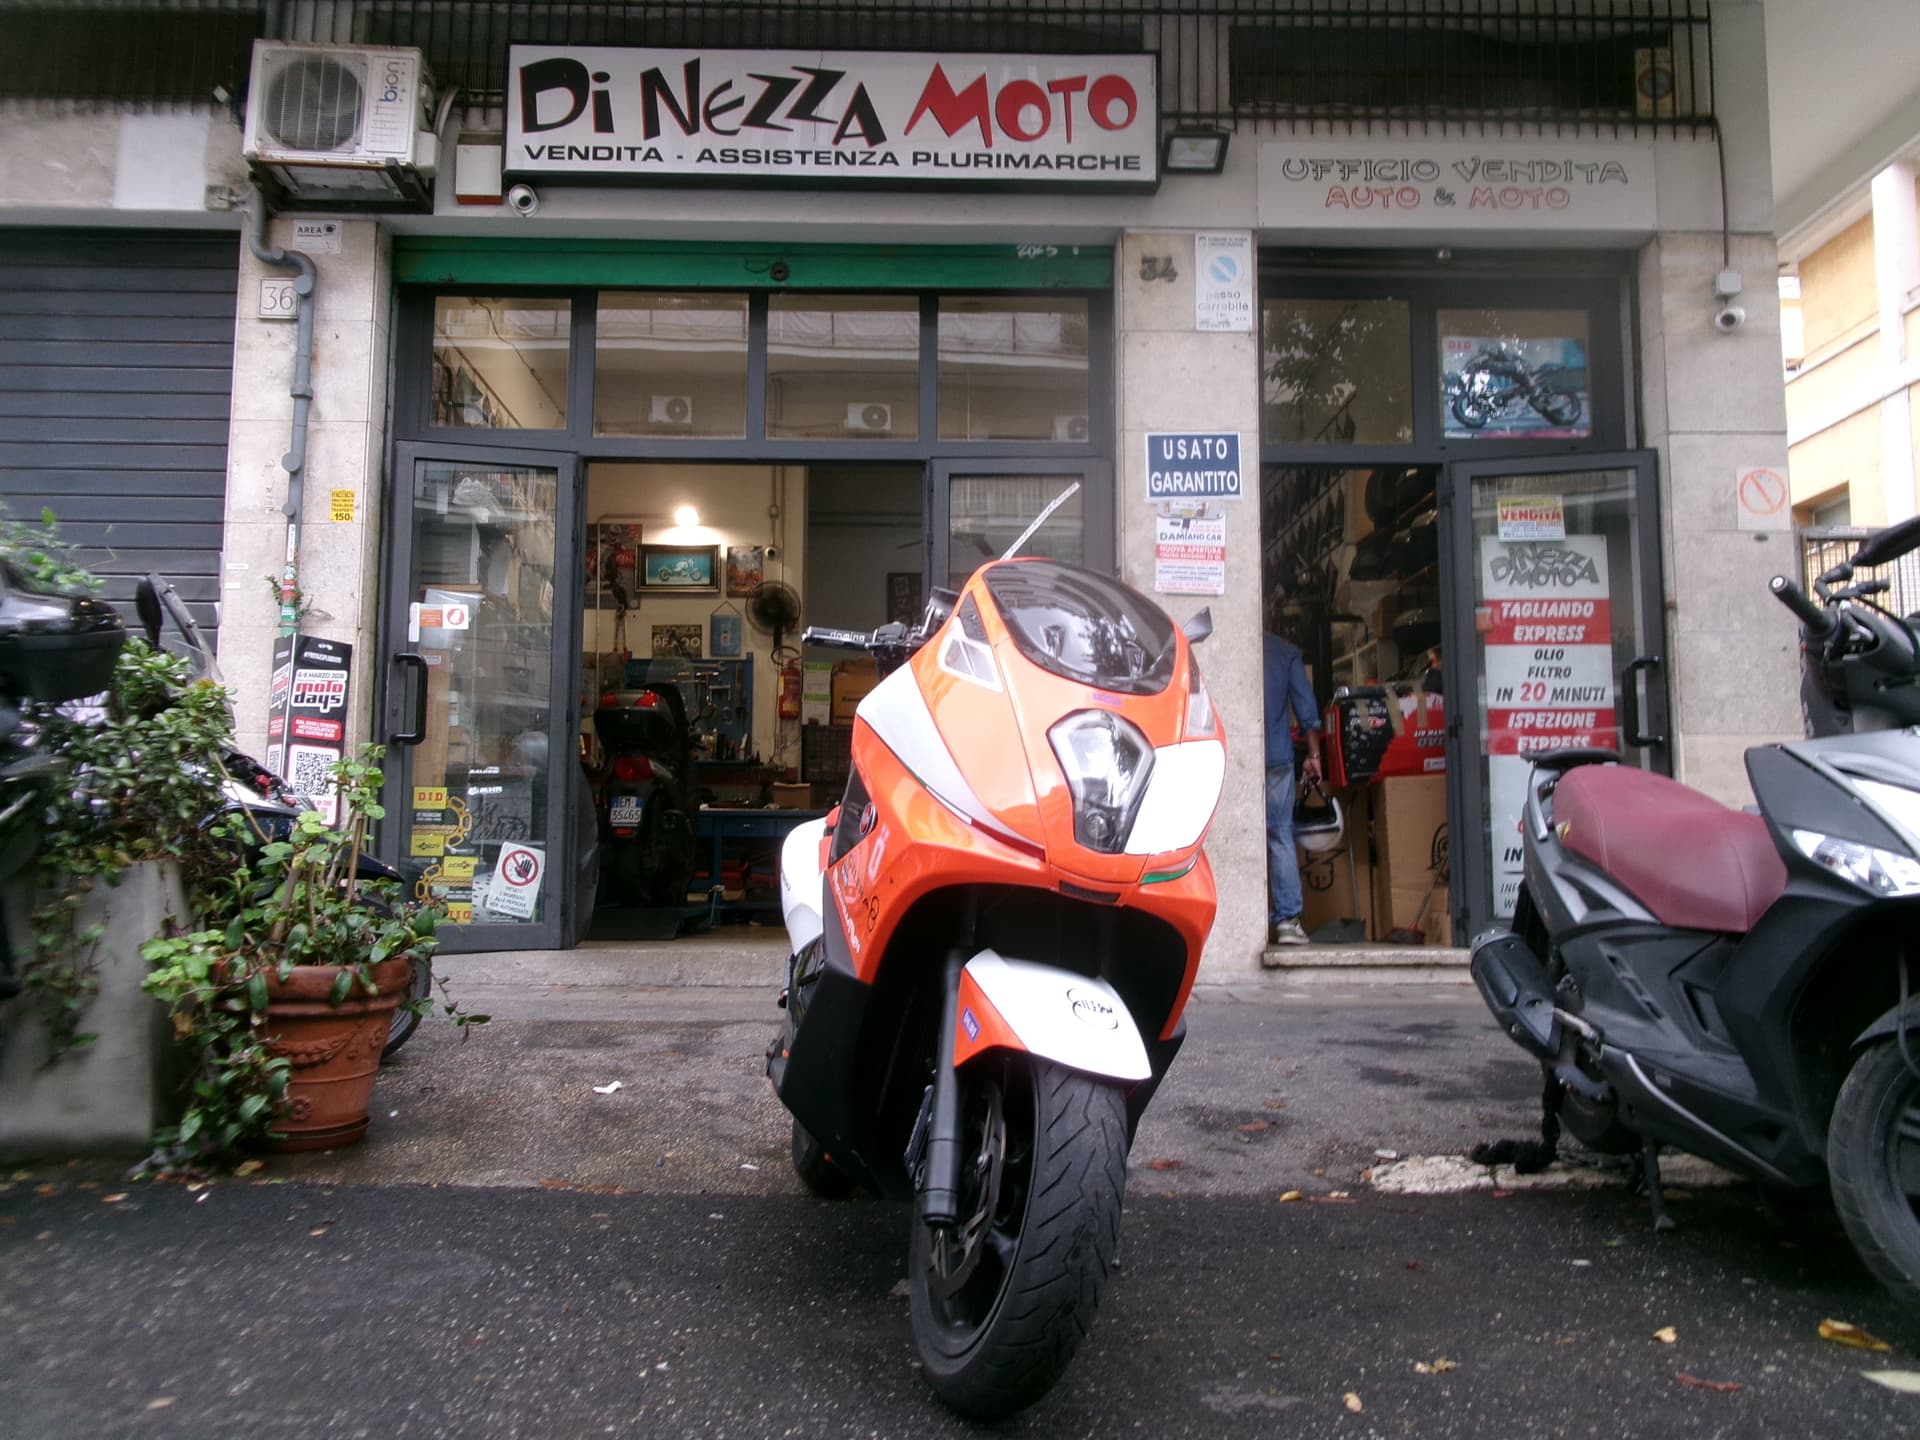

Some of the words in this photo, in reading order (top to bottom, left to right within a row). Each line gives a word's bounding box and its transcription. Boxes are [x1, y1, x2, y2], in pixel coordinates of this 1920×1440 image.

[903, 61, 1139, 149] MOTO
[523, 144, 665, 164] VENDITA
[695, 147, 901, 168] ASSISTENZA
[911, 150, 1142, 172] PLURIMARCHE
[1282, 158, 1441, 182] UFFICIO
[1451, 155, 1629, 184] VENDITA
[1324, 186, 1421, 209] AUTO
[1433, 187, 1456, 207] &
[1468, 186, 1571, 210] MOTO
[297, 226, 322, 234] AREA
[1138, 255, 1178, 283] 34
[262, 286, 294, 311] 36
[1198, 301, 1249, 312] carrabile
[1163, 438, 1228, 460] USATO
[1151, 470, 1239, 495] GARANTITO
[1500, 508, 1561, 521] VENDITA
[1159, 532, 1205, 541] DAMIANO
[1206, 532, 1222, 541] CAR
[1501, 601, 1595, 619] TAGLIANDO
[1513, 624, 1586, 643] EXPRESS
[1534, 648, 1565, 661] OLIO
[1527, 666, 1572, 679] FILTRO
[295, 680, 344, 693] moto
[1495, 687, 1514, 701] IN
[1519, 681, 1547, 702] 20
[1550, 686, 1606, 701] MINUTI
[293, 691, 342, 710] days
[1507, 711, 1597, 729] ISPEZIONE
[1517, 735, 1591, 753] EXPRESS
[1503, 847, 1524, 862] IN
